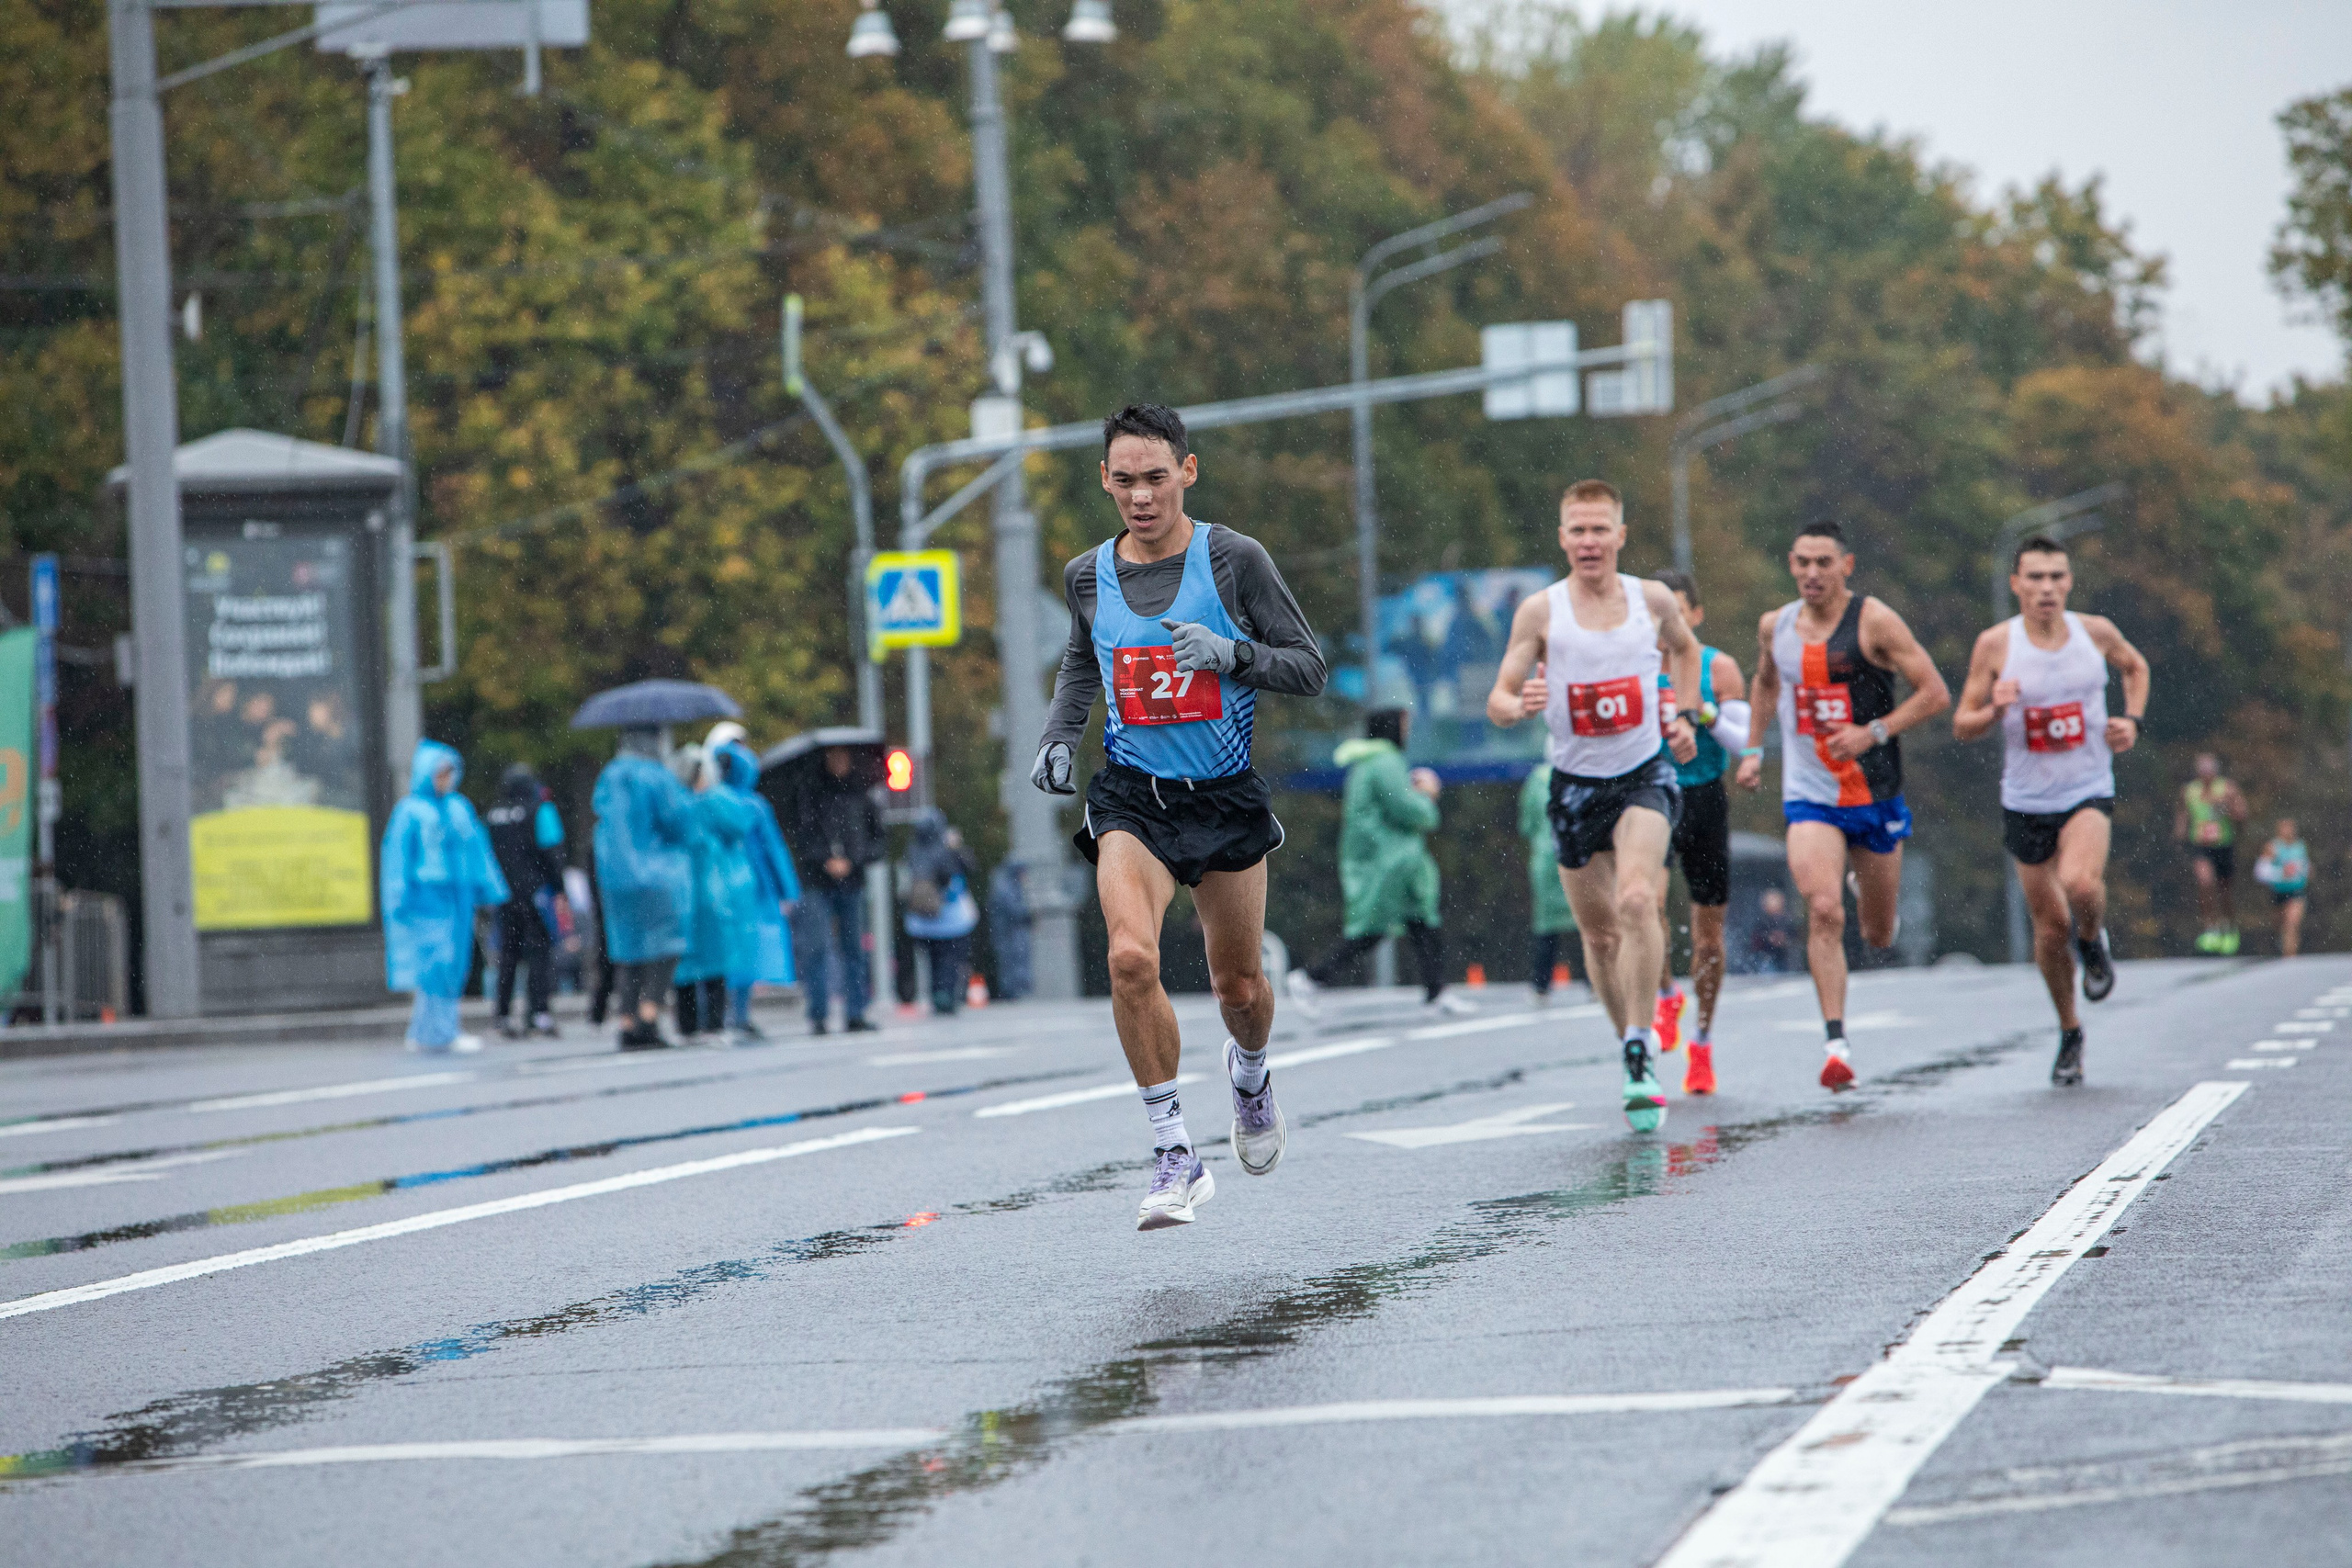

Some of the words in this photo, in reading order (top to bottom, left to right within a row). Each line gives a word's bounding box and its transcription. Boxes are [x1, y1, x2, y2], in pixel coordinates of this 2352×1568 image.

[1150, 671, 1194, 699] 27
[1596, 694, 1628, 719] 01
[1815, 699, 1848, 721] 32
